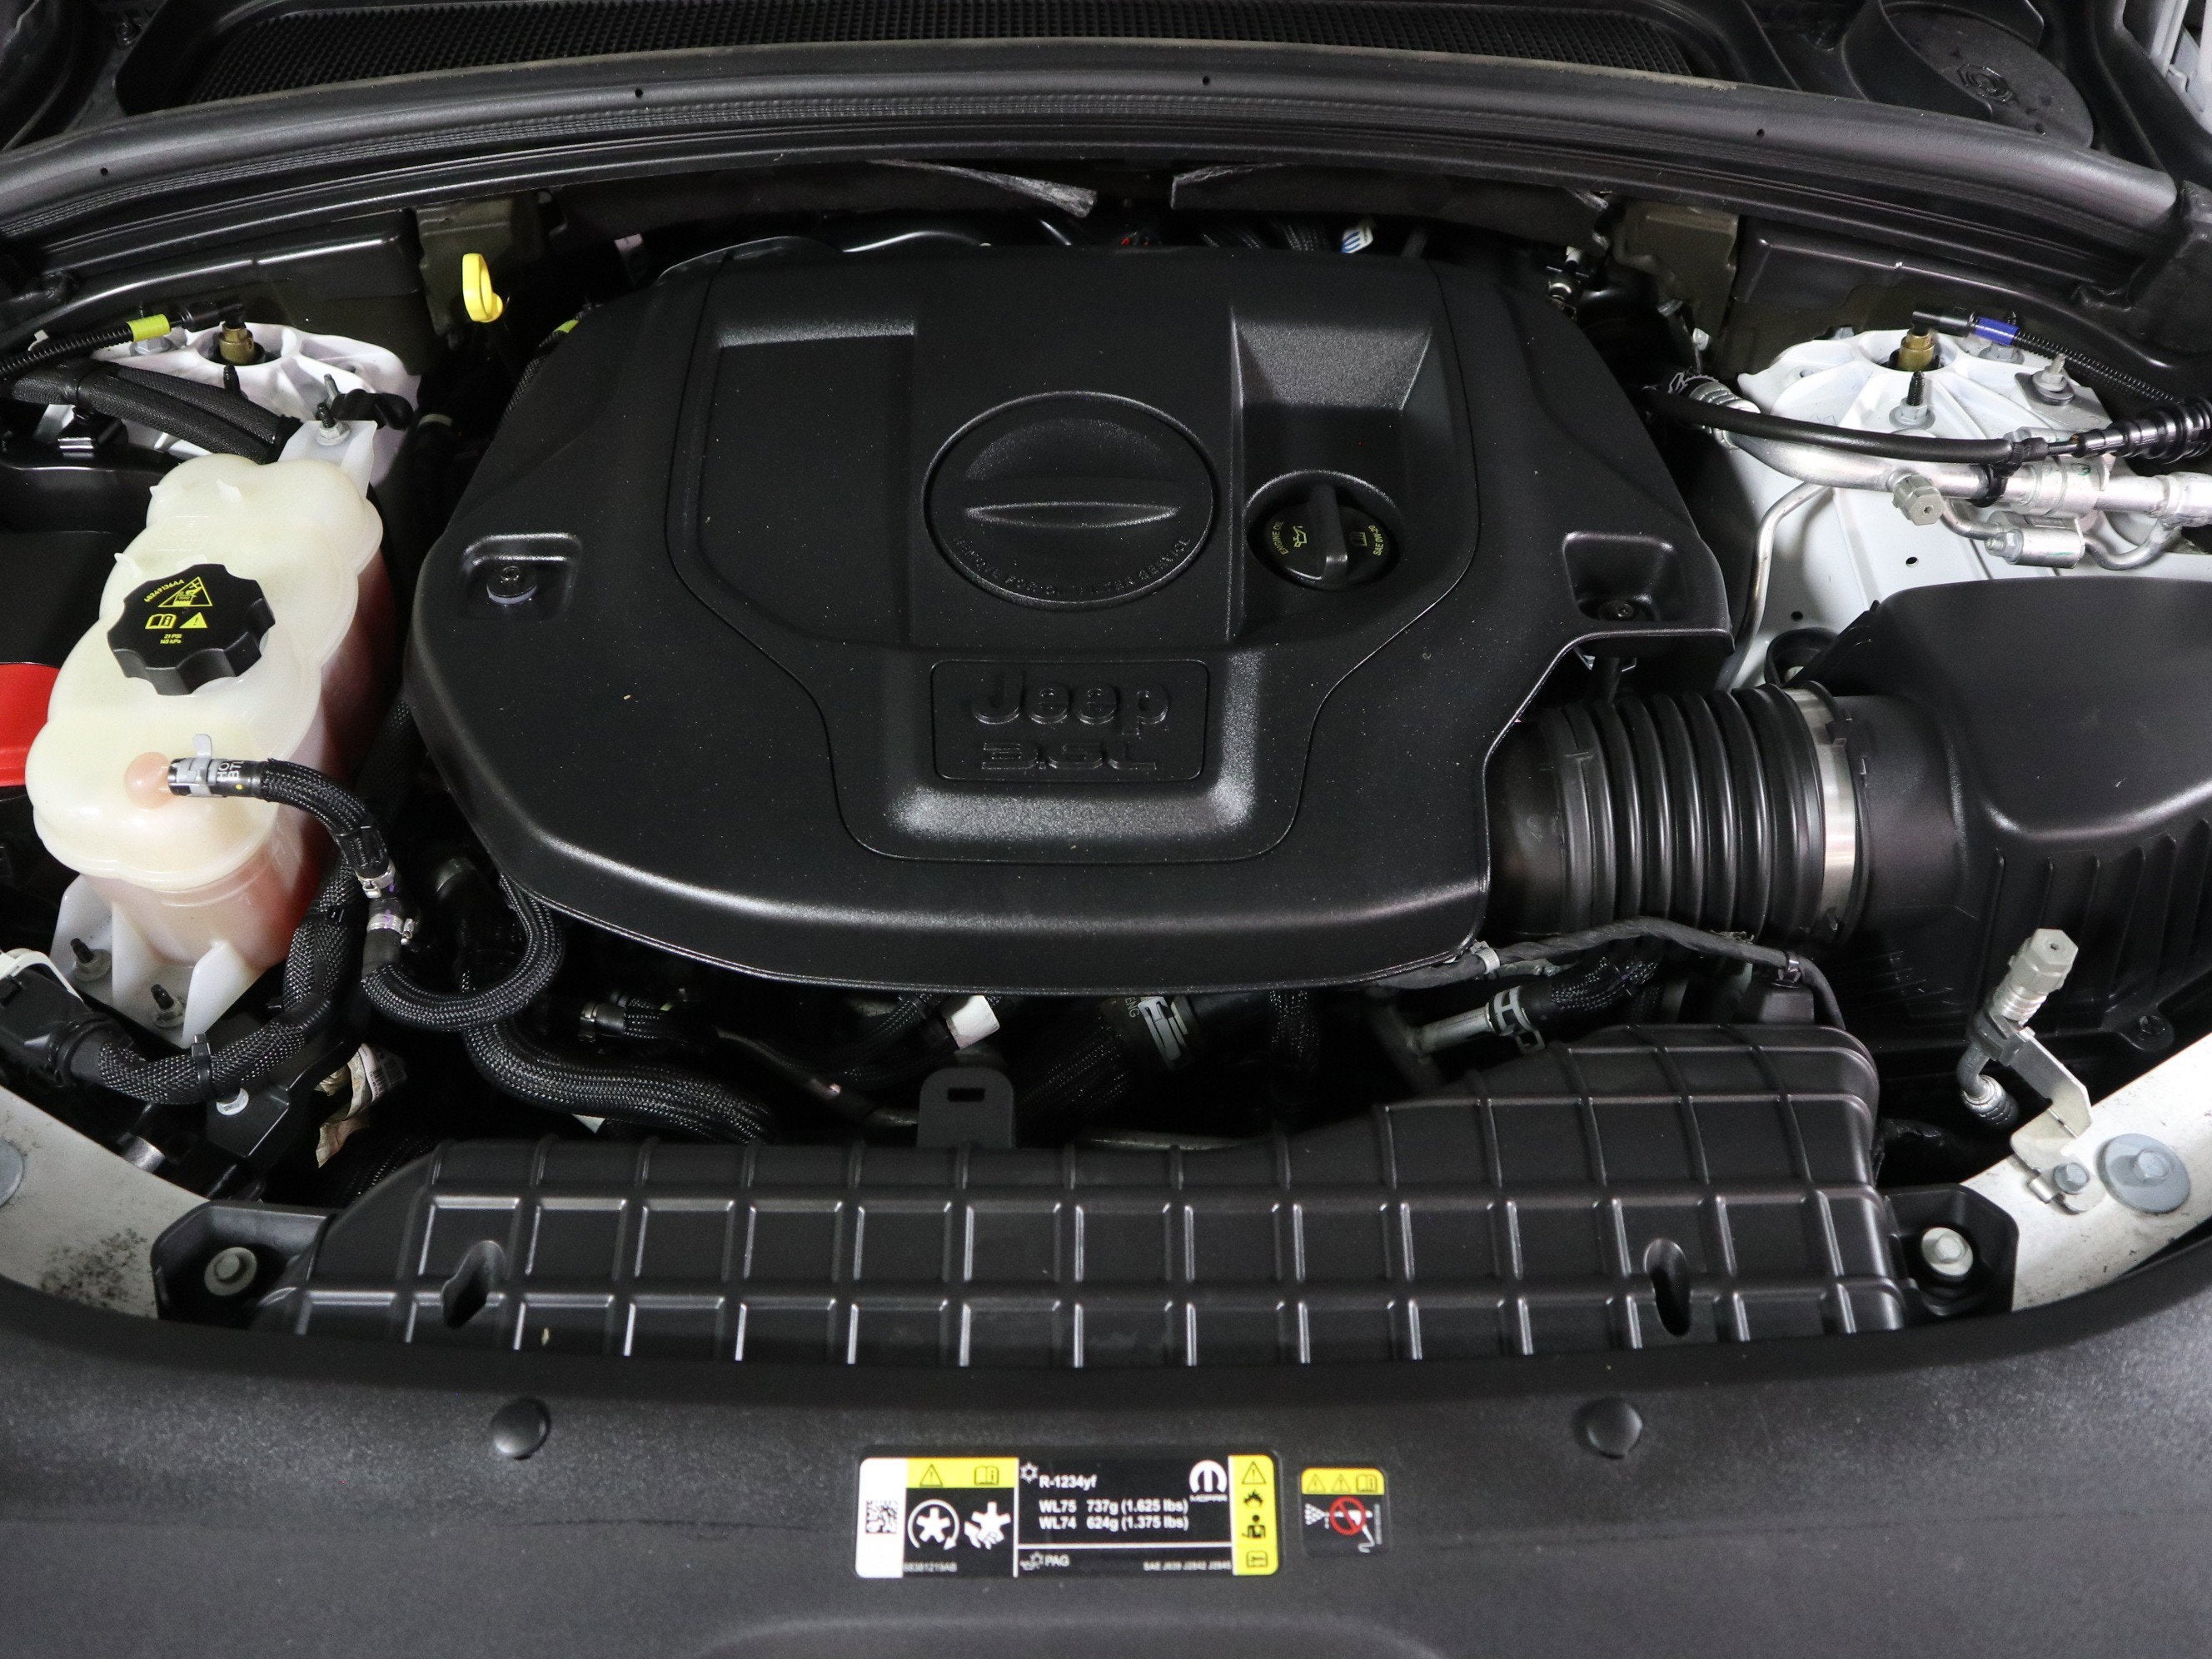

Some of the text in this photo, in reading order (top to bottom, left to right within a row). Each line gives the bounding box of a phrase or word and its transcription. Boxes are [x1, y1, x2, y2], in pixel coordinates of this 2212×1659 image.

[1273, 531, 1289, 555] ENGINE
[1373, 542, 1383, 556] SAE
[971, 666, 1169, 736] Jeep
[1039, 1473, 1098, 1491] R-1234yf
[1039, 1498, 1188, 1515] WL75 737g (1.625 lbs)
[1039, 1515, 1189, 1532] WL74 624g (1.375 lbs)
[1044, 1554, 1070, 1567] PAG
